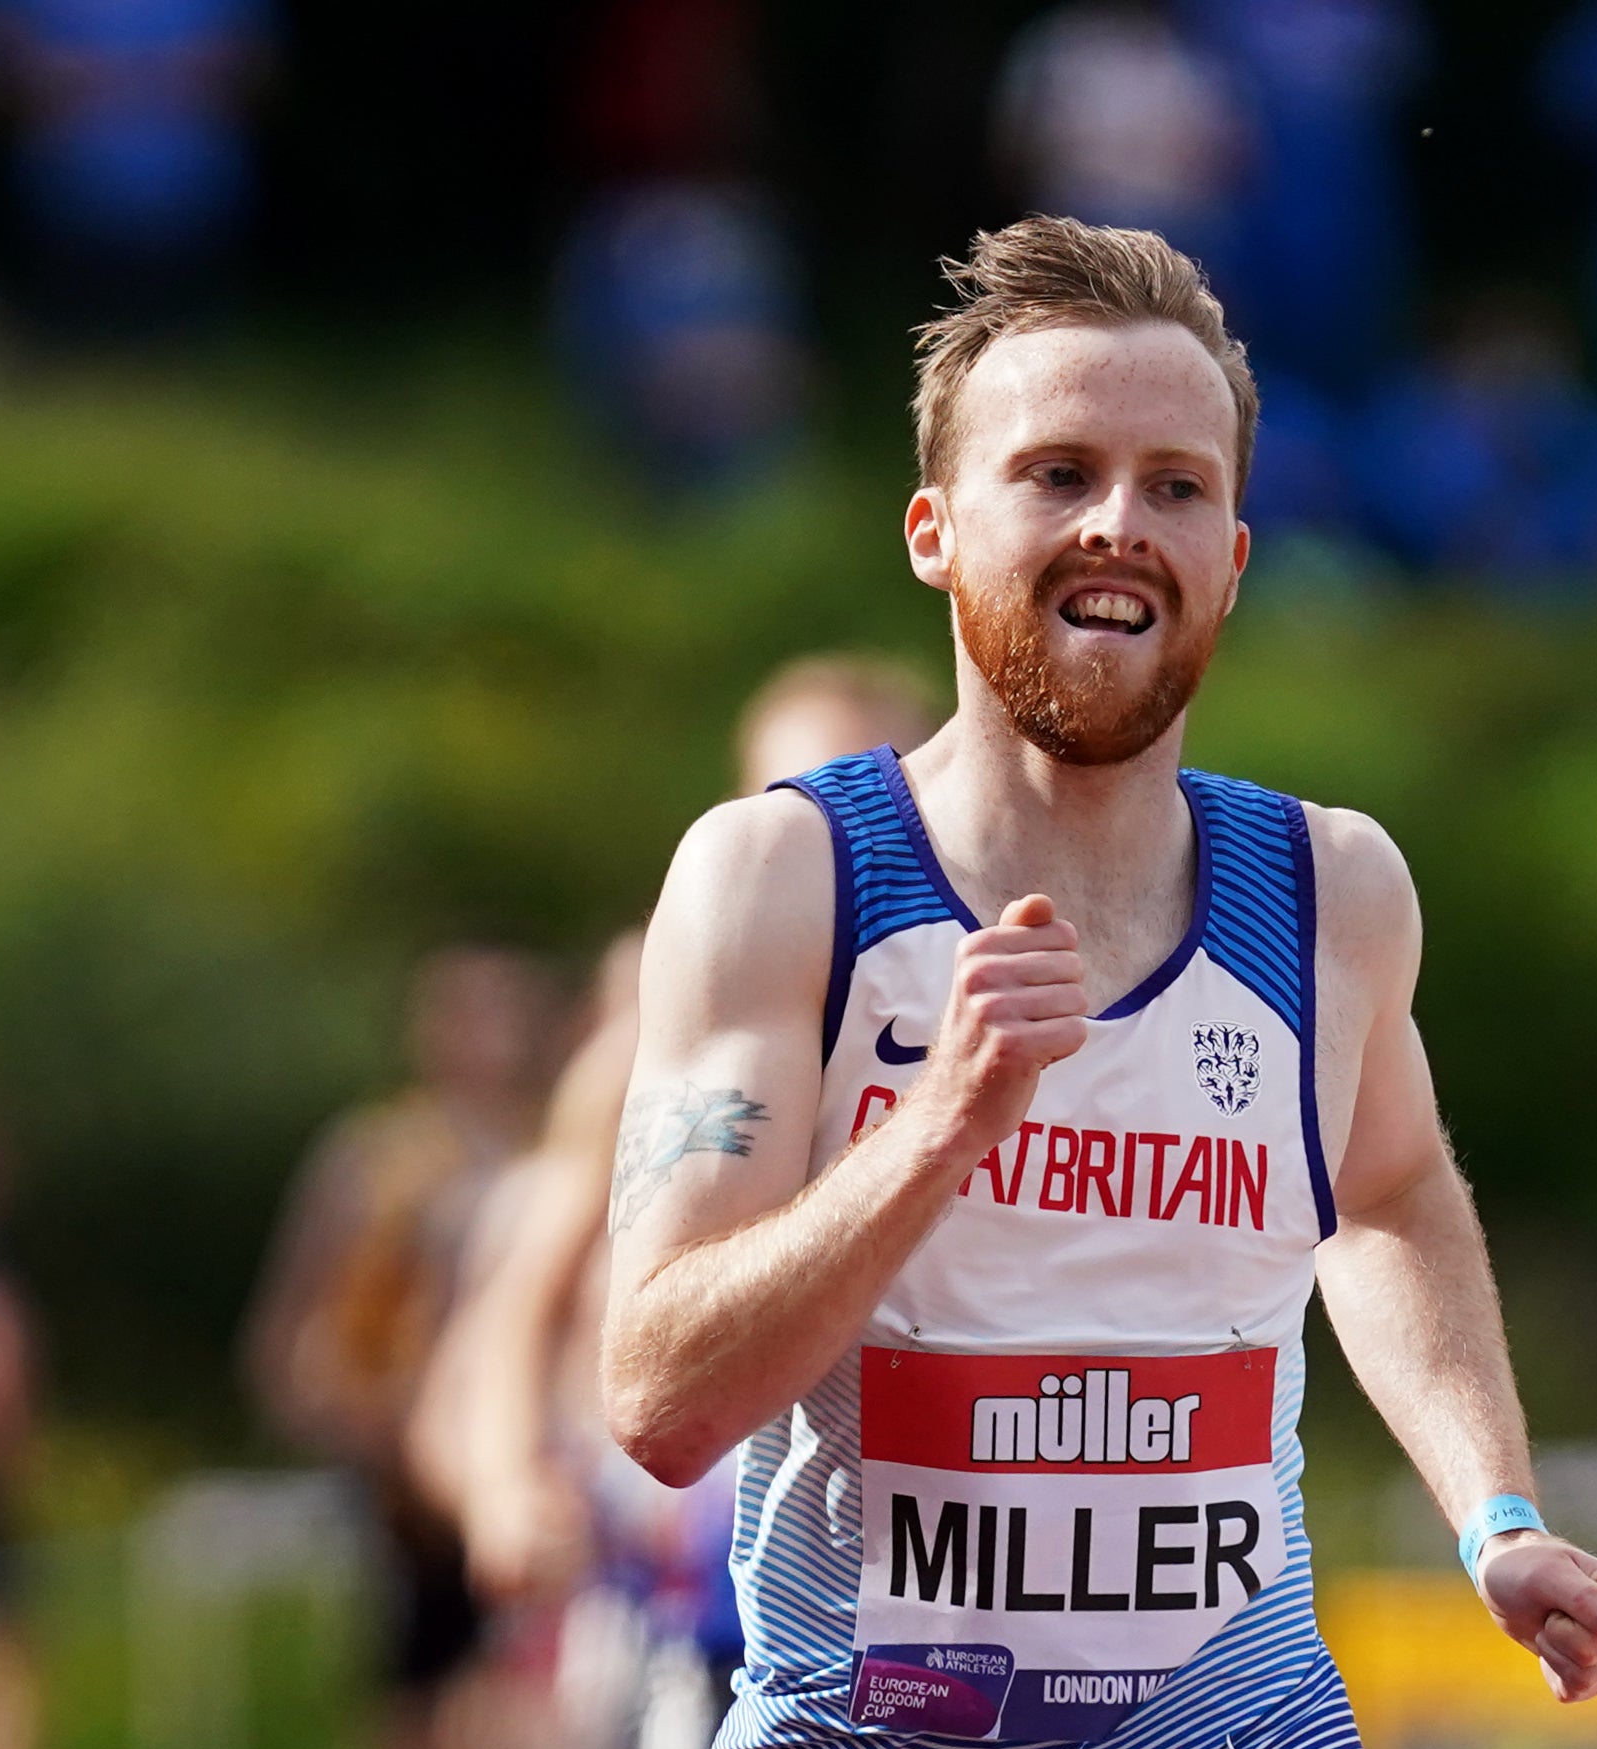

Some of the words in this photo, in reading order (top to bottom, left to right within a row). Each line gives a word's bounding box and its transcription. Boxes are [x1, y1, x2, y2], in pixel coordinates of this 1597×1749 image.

[1039, 1125, 1268, 1232] BRITAIN
[970, 1368, 1201, 1463] müller
[889, 1493, 1262, 1613] MILLER
[945, 1649, 1007, 1665] EUROPEAN
[945, 1661, 1007, 1676] ATHLETICS
[869, 1675, 950, 1698] EUROPEAN
[1043, 1674, 1133, 1704] LONDON
[863, 1703, 896, 1719] CUP
[868, 1690, 926, 1710] 10,000M
